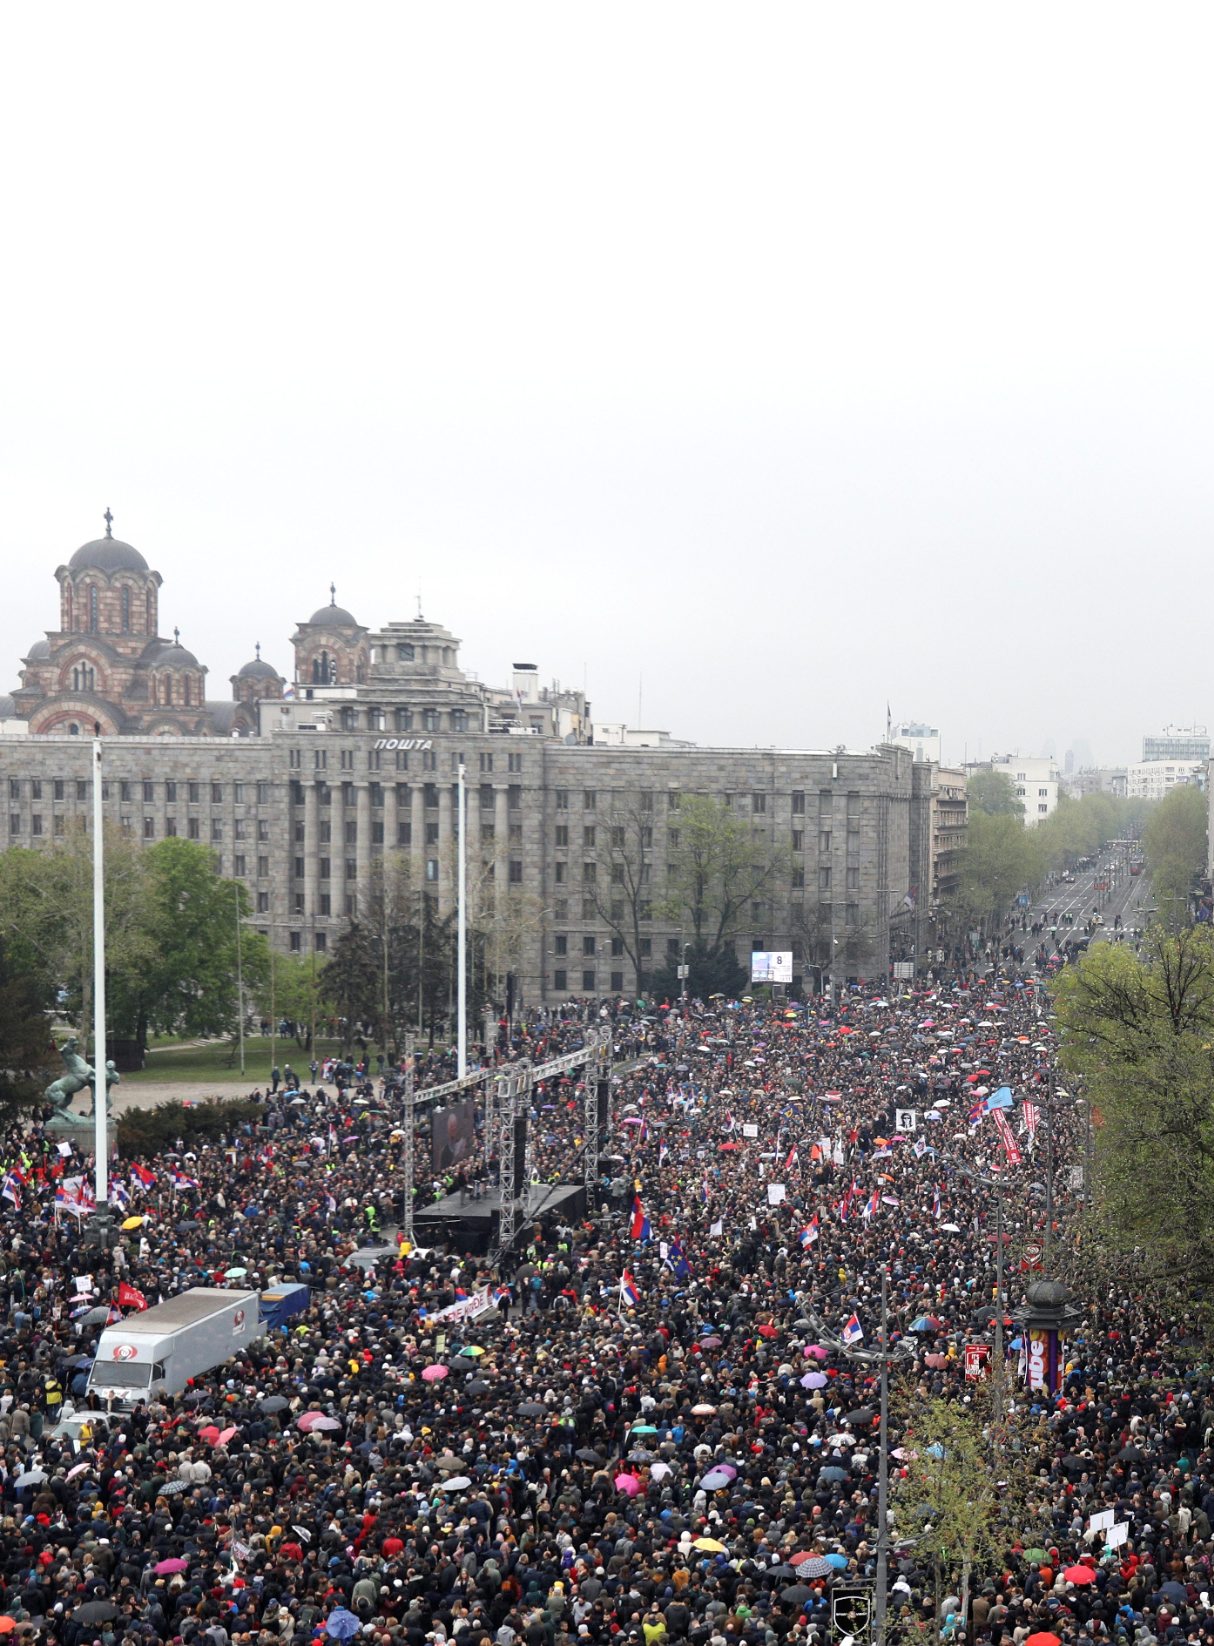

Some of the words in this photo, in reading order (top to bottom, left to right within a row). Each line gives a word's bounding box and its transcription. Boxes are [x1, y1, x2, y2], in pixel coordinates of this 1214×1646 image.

[374, 738, 433, 750] ПОШТА
[776, 955, 783, 965] 8
[1027, 1340, 1045, 1391] ube
